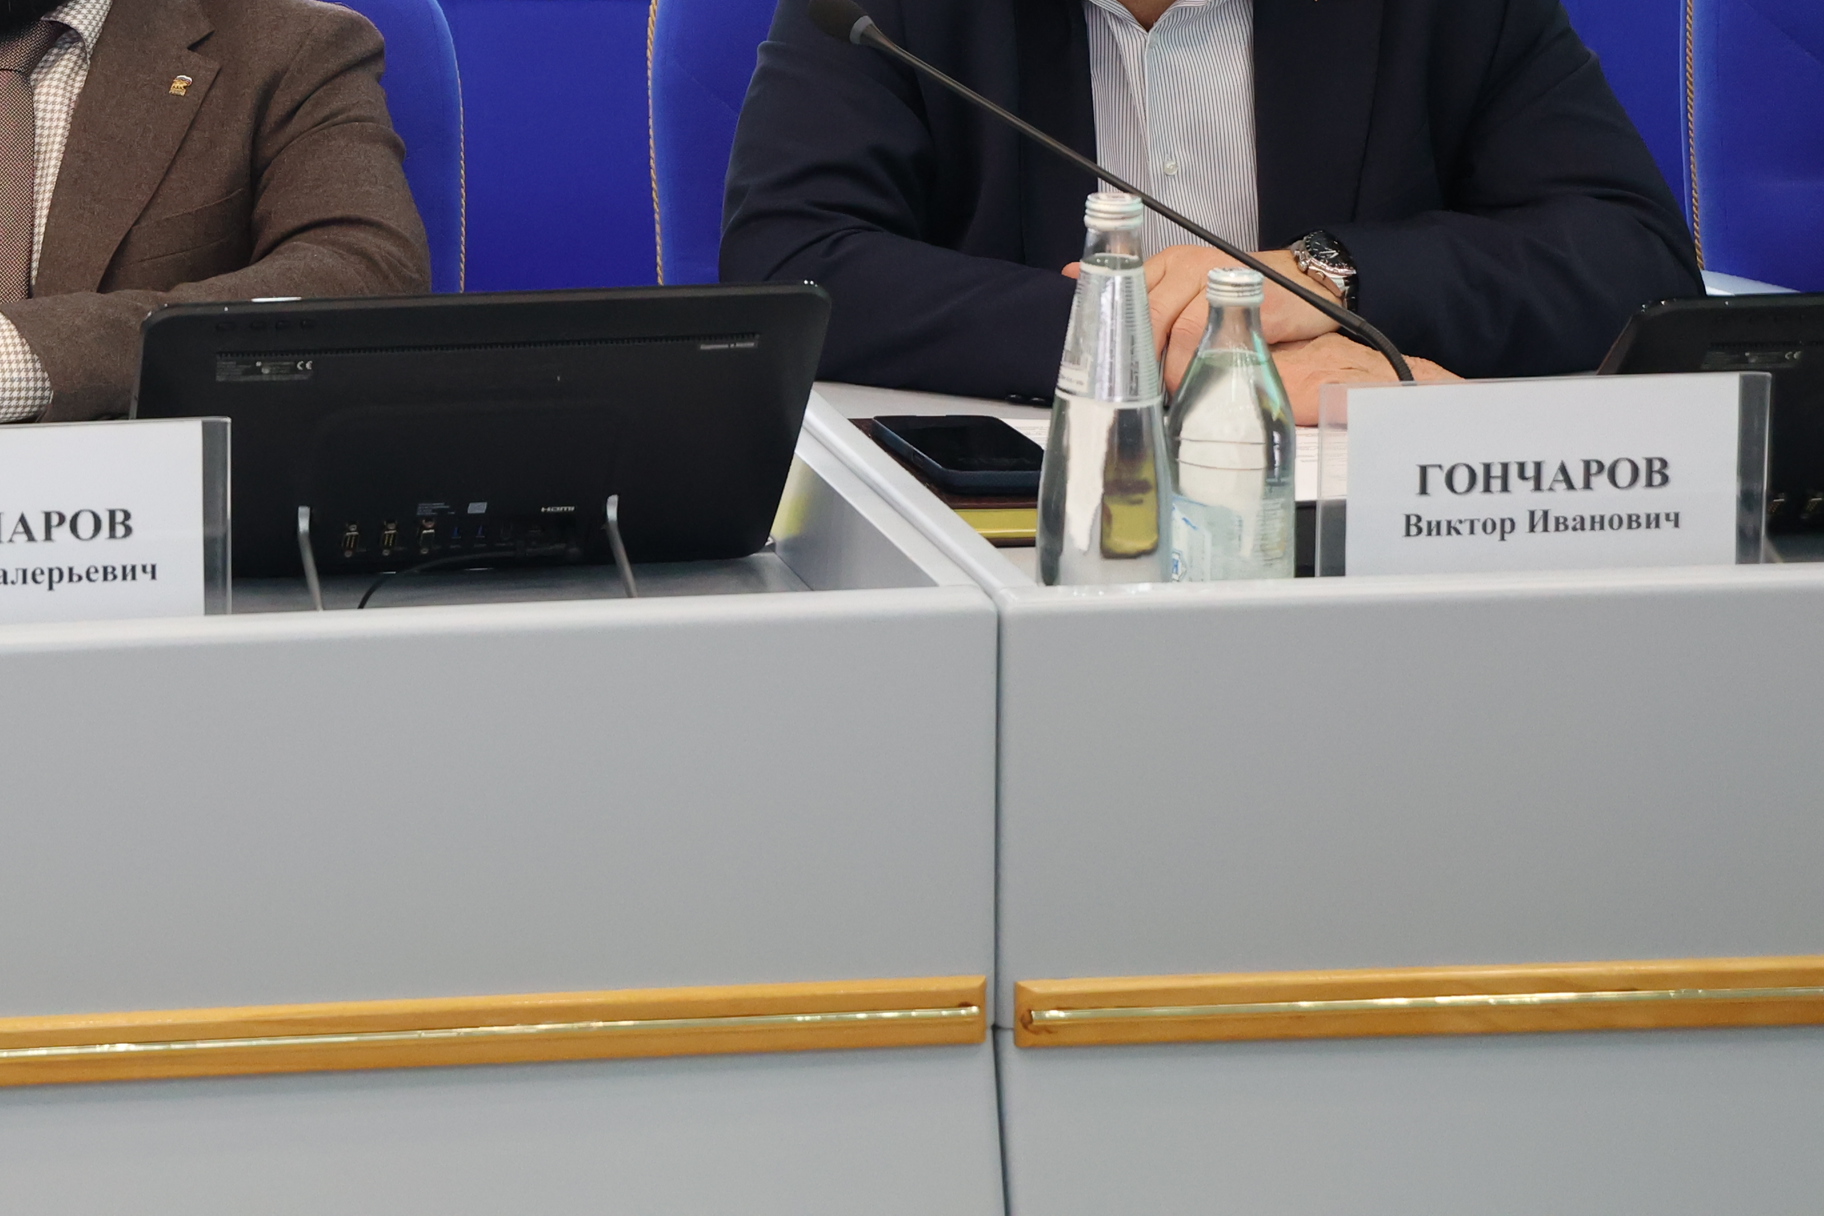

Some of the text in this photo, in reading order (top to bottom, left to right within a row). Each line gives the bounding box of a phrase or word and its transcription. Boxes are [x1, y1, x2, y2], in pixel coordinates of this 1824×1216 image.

[1417, 456, 1671, 497] ГОНЧАРОВ
[1404, 508, 1680, 542] Виктор Иванович
